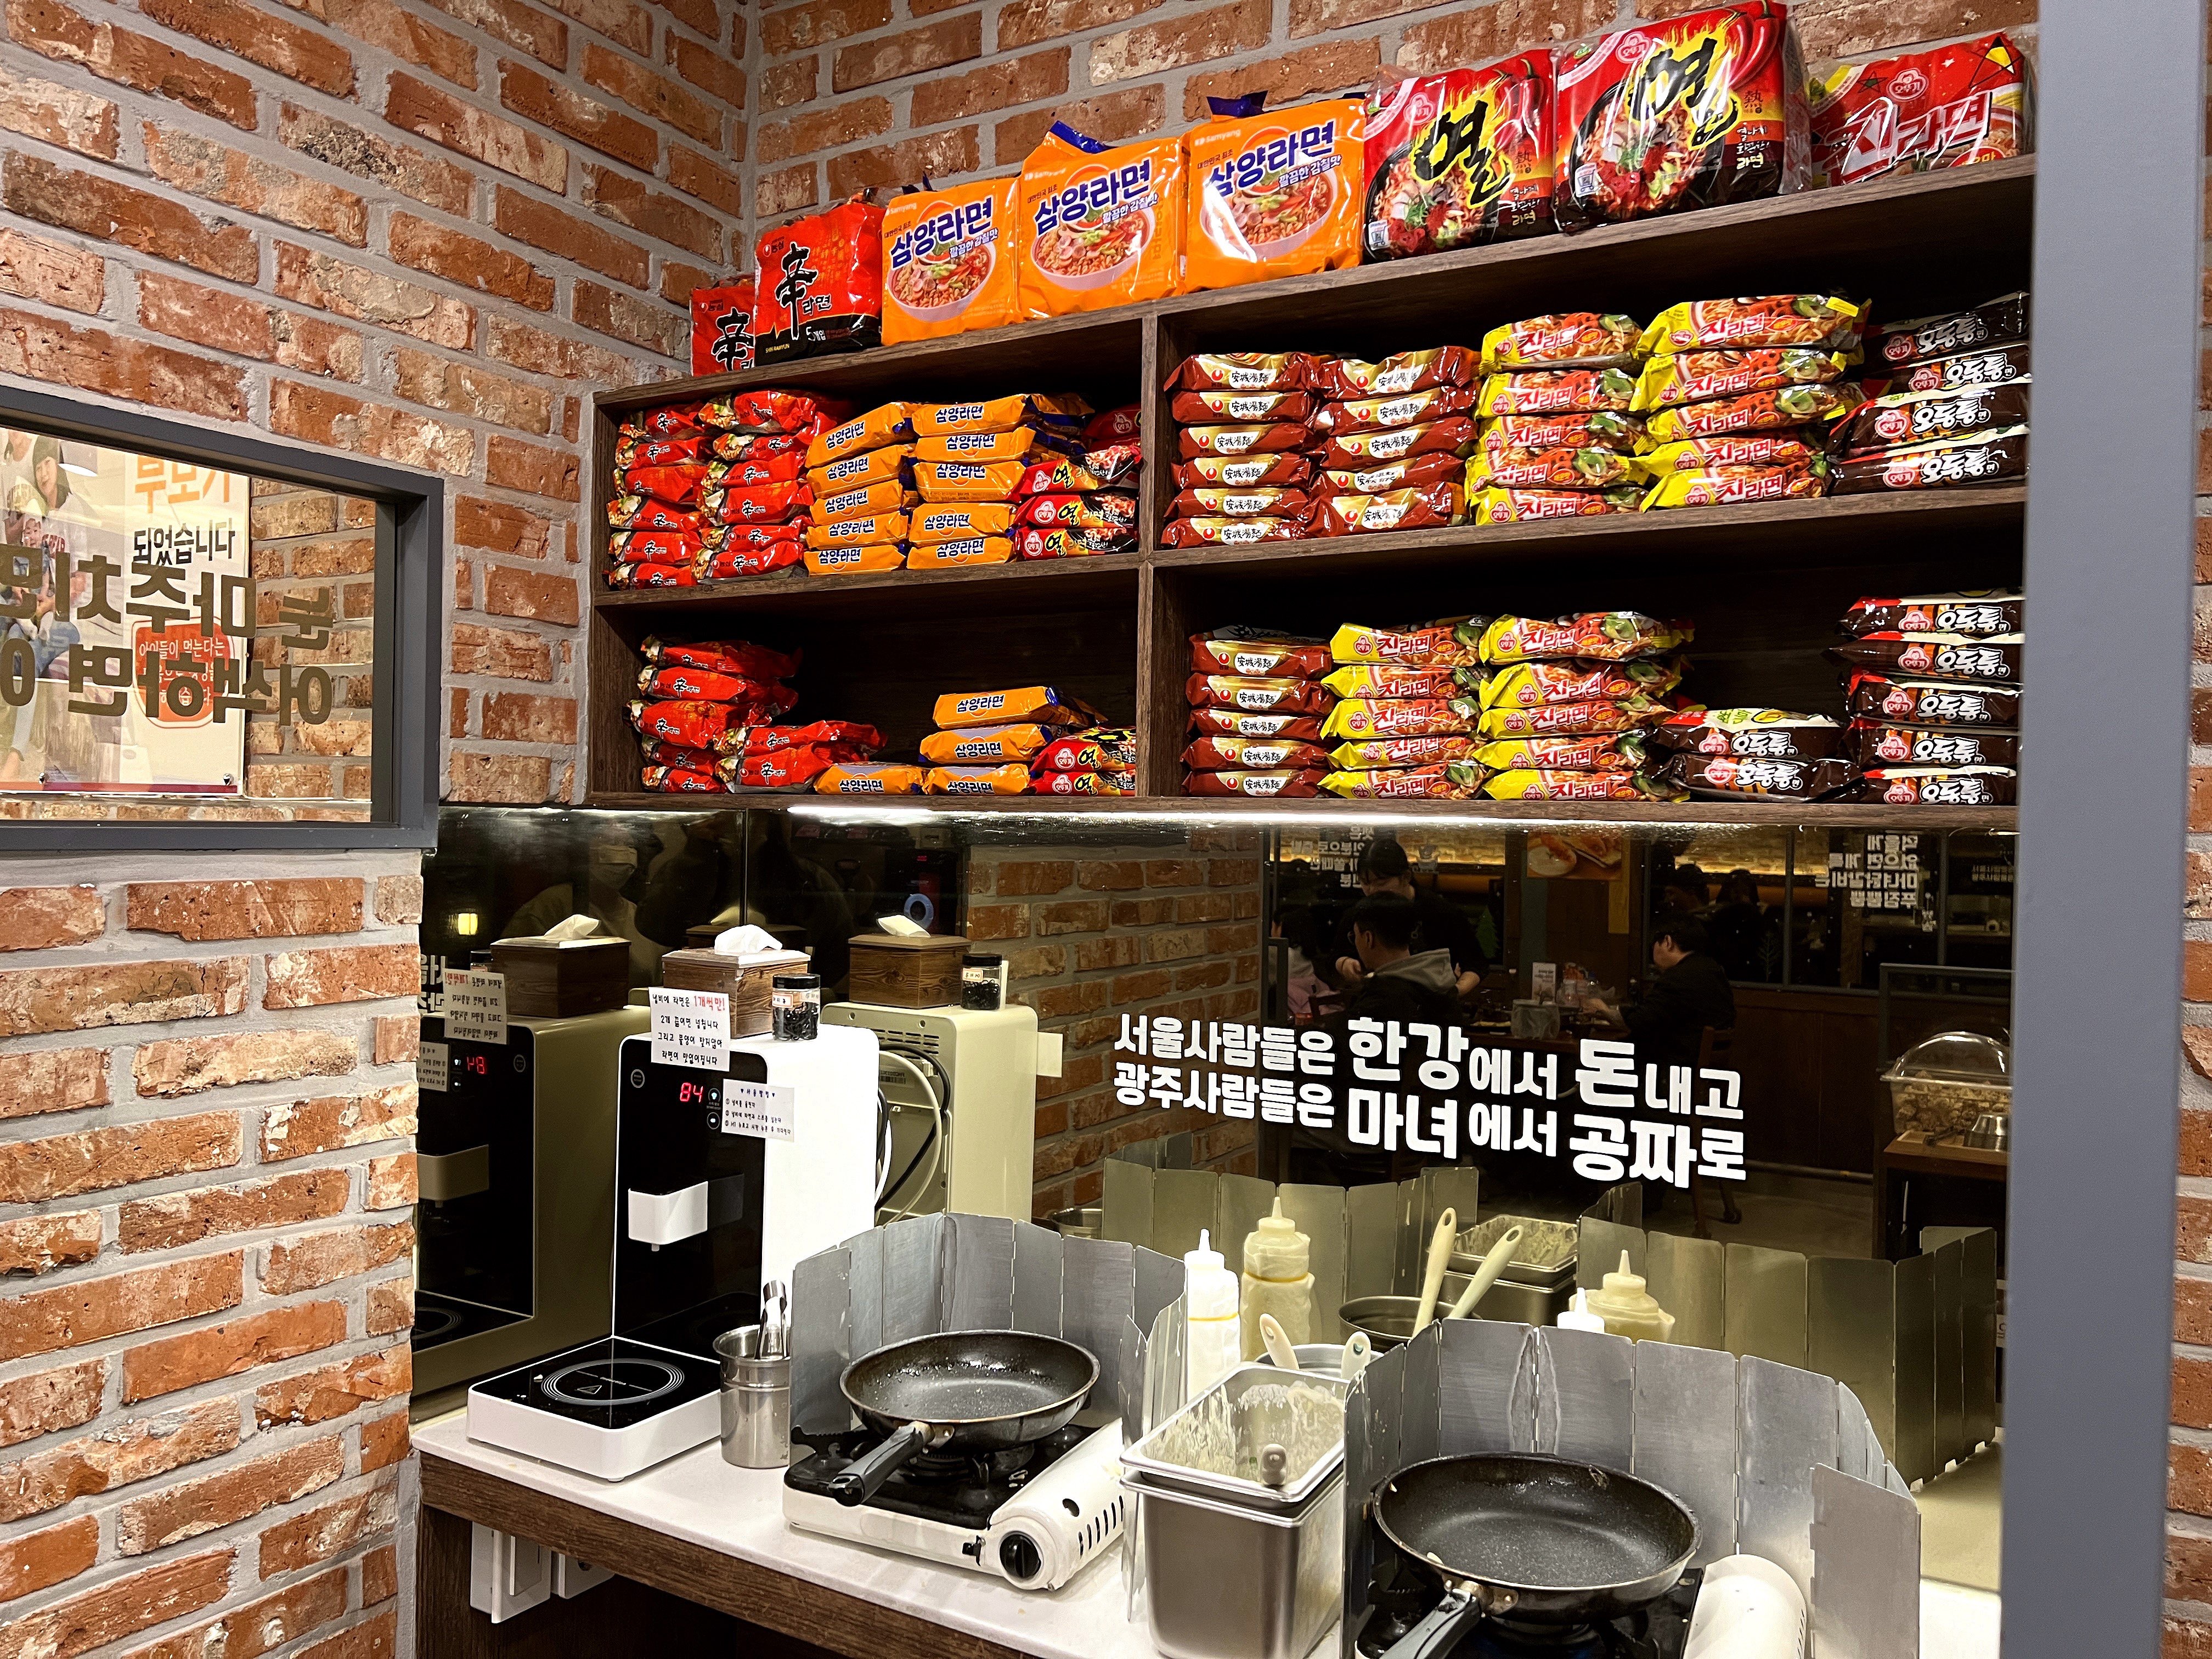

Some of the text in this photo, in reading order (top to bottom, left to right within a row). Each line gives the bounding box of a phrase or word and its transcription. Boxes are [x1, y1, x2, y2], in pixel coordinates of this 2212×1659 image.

[1894, 82, 1920, 94] 오뚜기
[1206, 129, 1241, 143] Samyang
[1197, 149, 1234, 169] 대한민국 최초
[1210, 121, 1334, 197] 삼양라면
[1413, 100, 1511, 205] 열
[1736, 154, 1764, 169] 라면
[1278, 154, 1342, 188] 깔끔한 감칠맛
[1035, 159, 1150, 236] 삼양라면
[1511, 210, 1536, 225] 라면
[890, 196, 992, 269] 삼양라면
[1699, 313, 1765, 346] 진라면
[1684, 371, 1750, 400] 진라면
[1515, 386, 1573, 413] 진라면
[935, 405, 983, 424] 삼양라면
[1686, 409, 1748, 438] 진라면
[1912, 397, 1990, 433] 오동통면
[826, 421, 865, 449] 삼양라면
[946, 433, 995, 451] 삼양라면
[1508, 425, 1561, 448] 진라면
[1704, 439, 1771, 468] 진라면
[827, 456, 869, 481] 삼양라면
[936, 464, 986, 479] 삼양라면
[825, 490, 868, 514] 삼양라면
[1716, 475, 1783, 505] 진라면
[1516, 496, 1577, 521] 진라면
[829, 518, 874, 537] 삼양라면
[924, 514, 970, 530] 삼양라면
[133, 518, 235, 566] 되었습니다
[936, 539, 984, 558] 삼양라면
[819, 548, 861, 566] 삼양라면
[1376, 634, 1430, 659] 진라면
[1520, 629, 1576, 656] 진라면
[1935, 647, 2010, 676] 오동통면
[956, 694, 1005, 713] 삼양라면
[1916, 694, 1991, 722] 오동통면
[1531, 705, 1589, 732] 진라면
[955, 742, 1003, 758] 삼양라면
[1536, 748, 1592, 768] 진라면
[1914, 737, 1986, 764] 오동통면
[839, 778, 883, 793] 삼양라면
[947, 779, 994, 794] 삼양라면
[1375, 777, 1425, 799] 진라면
[1548, 781, 1608, 801] 진라면
[1921, 778, 1993, 804] 오동통면
[652, 994, 670, 1004] 냄비에
[673, 996, 690, 1007] 라면은
[661, 1015, 670, 1024] 2개
[695, 1018, 718, 1030] 넘칩니다
[658, 1032, 674, 1041] 그리고
[679, 1034, 695, 1046] 물양이
[1114, 1013, 1335, 1075] 서울사람들은
[662, 1050, 679, 1062] 라면이
[680, 1082, 703, 1103] 84
[1114, 1062, 1335, 1128] 광주사람들은
[1570, 1114, 1746, 1188] 공짜로
